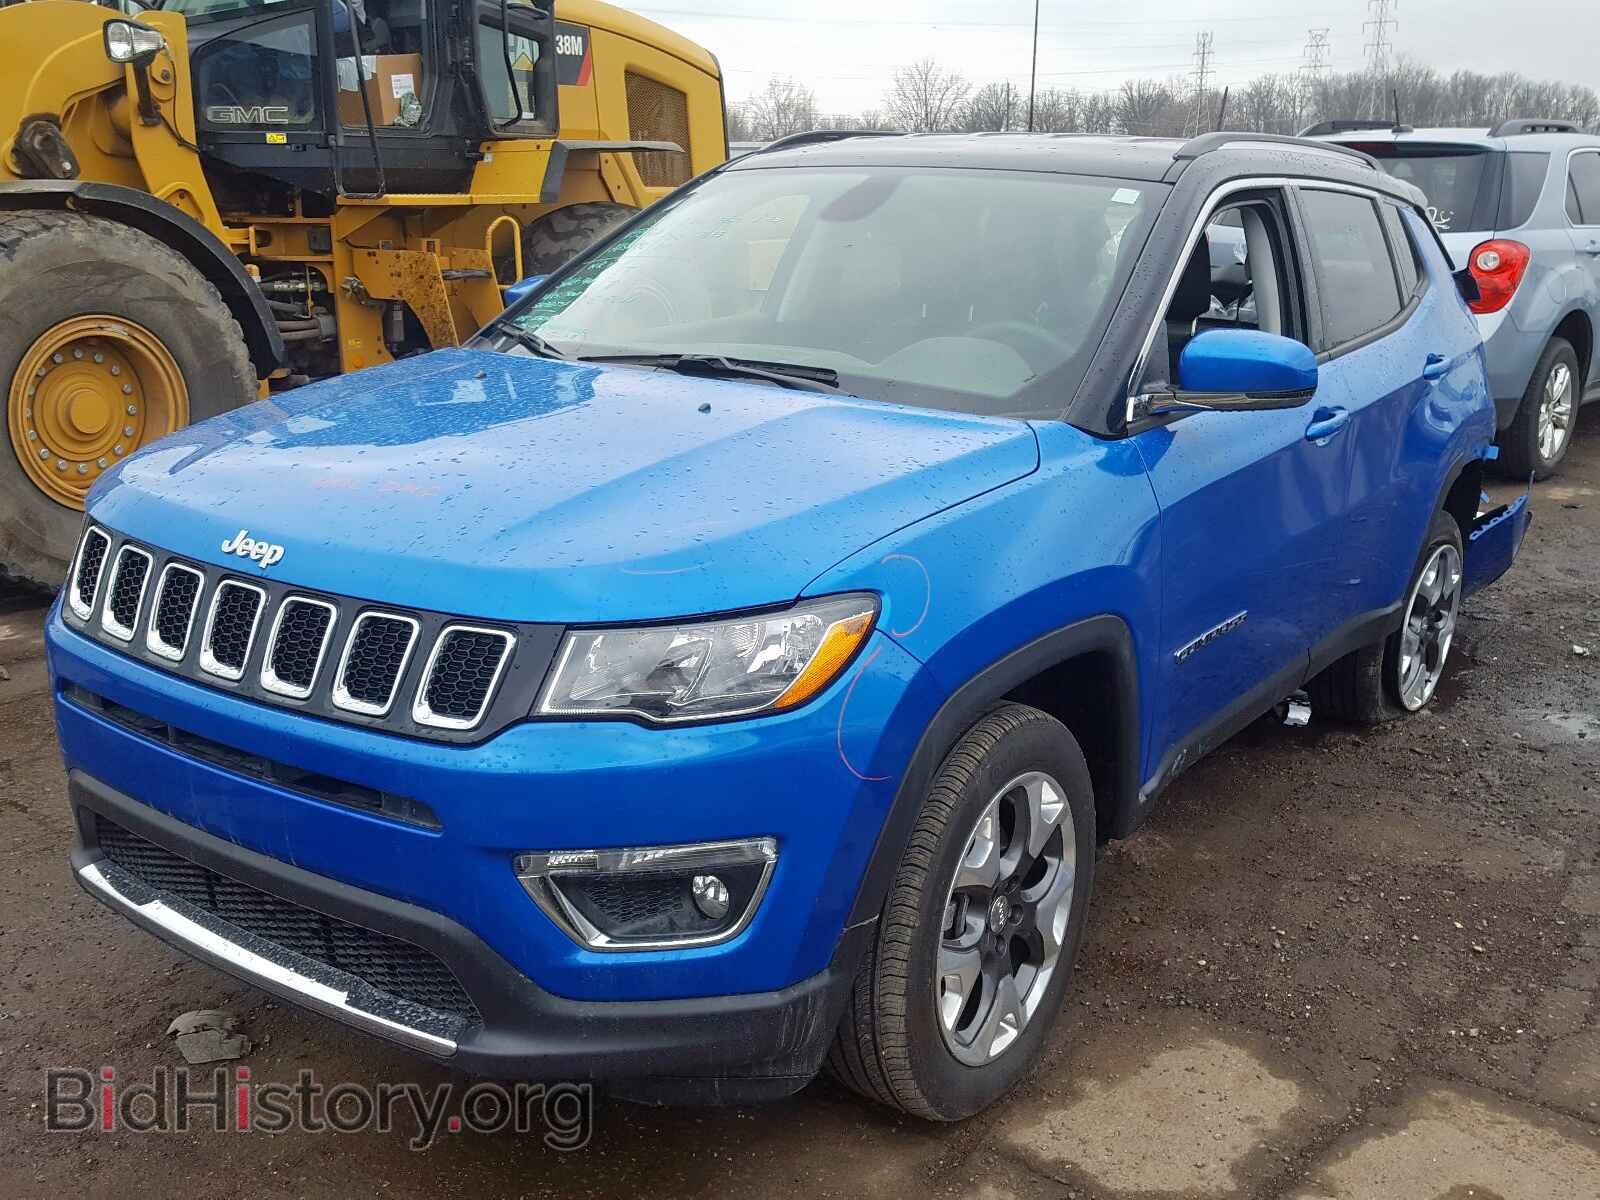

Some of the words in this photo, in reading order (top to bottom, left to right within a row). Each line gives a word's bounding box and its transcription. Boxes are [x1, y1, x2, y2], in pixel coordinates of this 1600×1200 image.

[555, 34, 583, 56] 38M
[206, 106, 289, 124] GMC
[221, 529, 285, 569] Jeep
